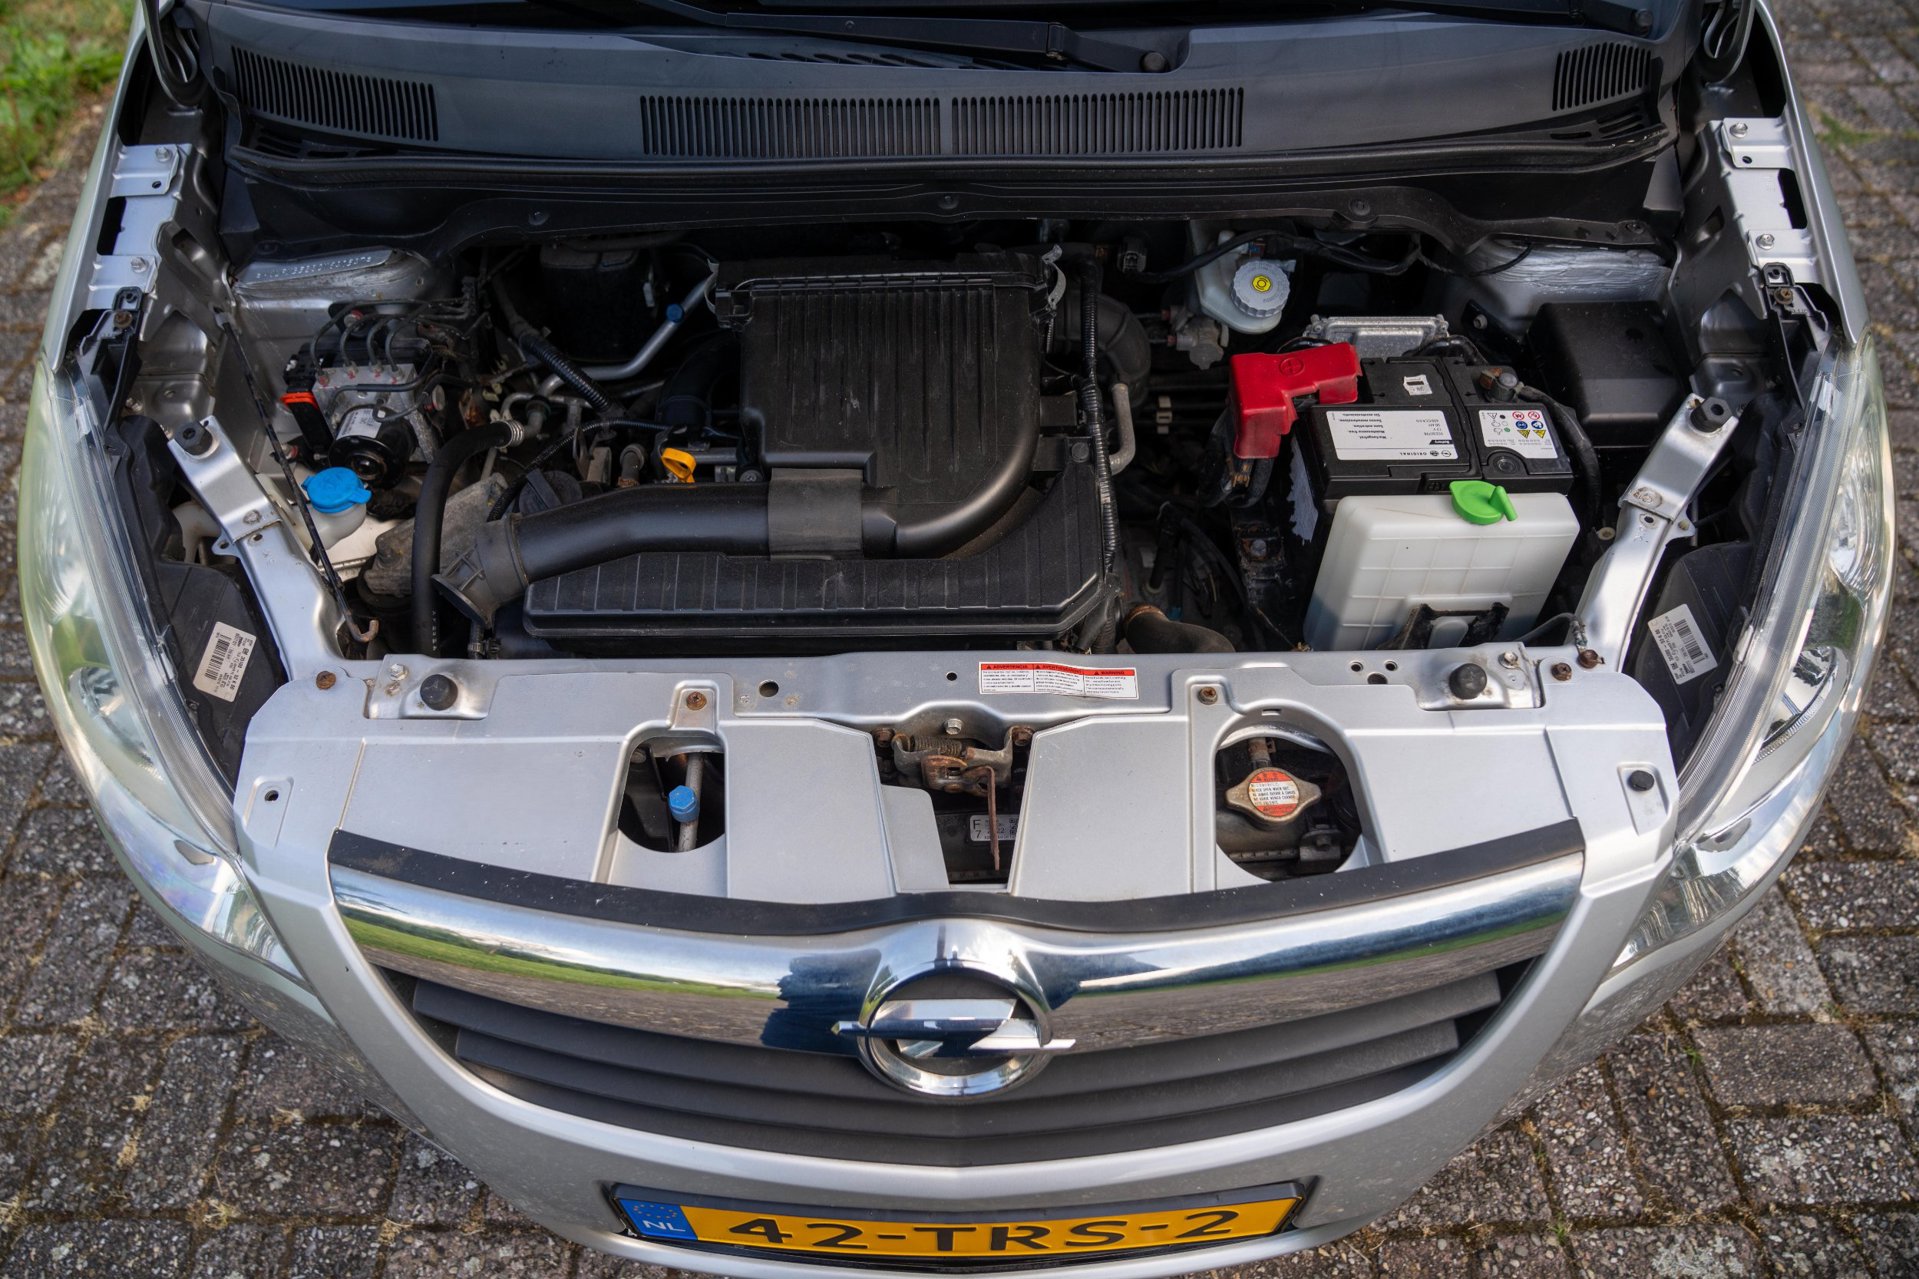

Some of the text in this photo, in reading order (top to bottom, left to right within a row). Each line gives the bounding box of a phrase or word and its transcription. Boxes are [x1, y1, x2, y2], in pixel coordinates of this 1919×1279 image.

[973, 819, 981, 830] F
[975, 830, 982, 839] 7
[642, 1219, 686, 1233] NL
[728, 1210, 1239, 1252] 42-TRS-2
